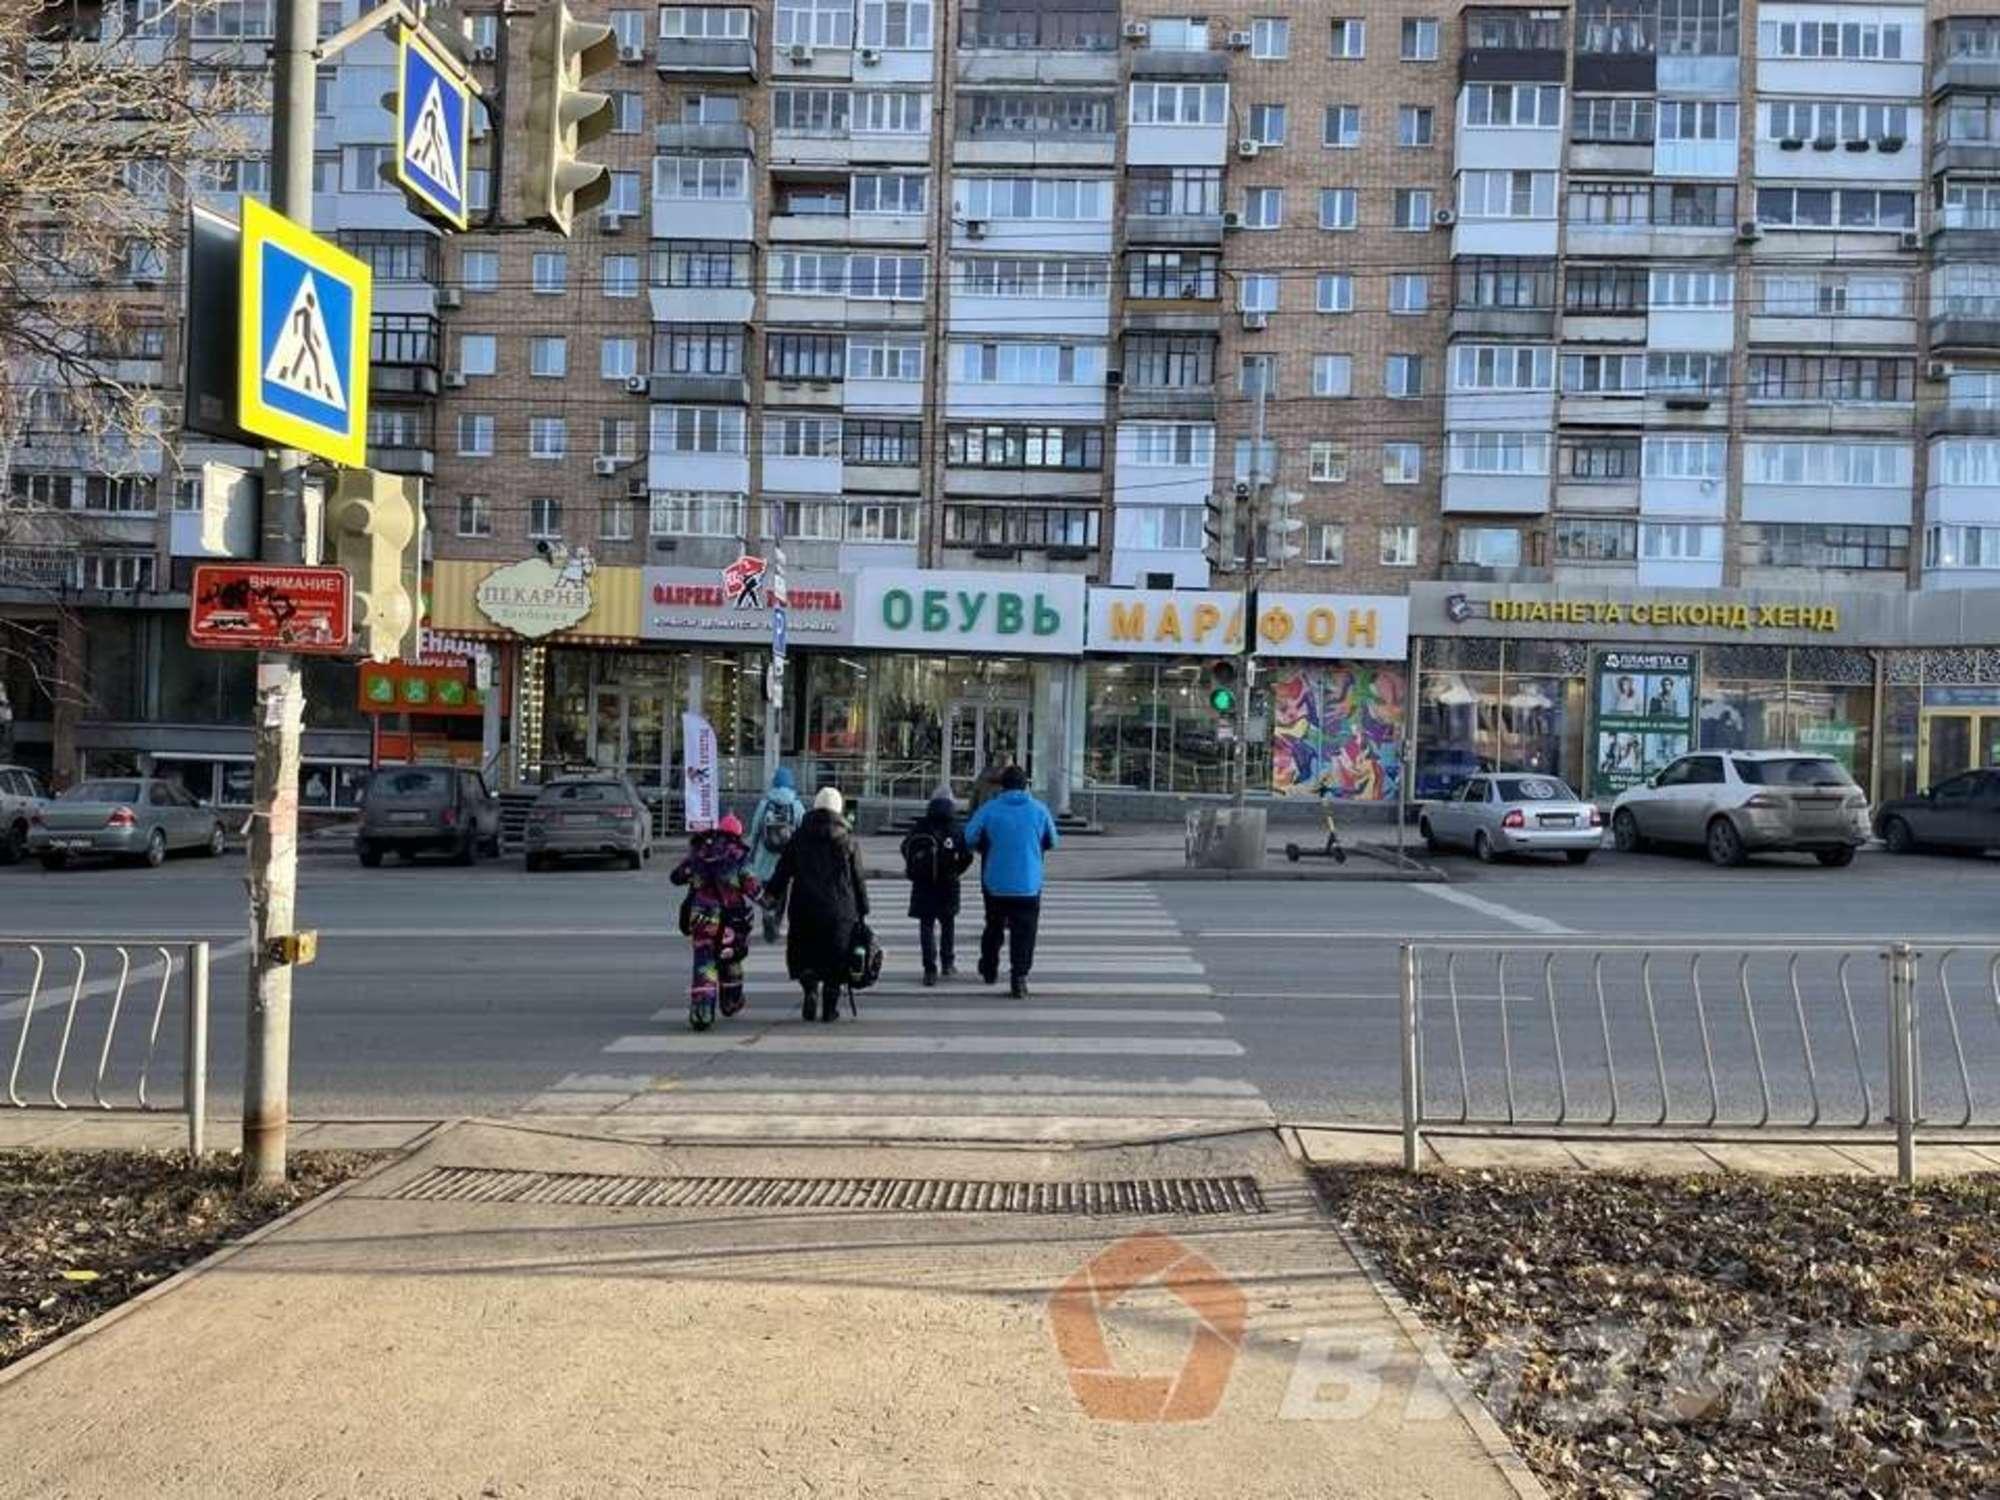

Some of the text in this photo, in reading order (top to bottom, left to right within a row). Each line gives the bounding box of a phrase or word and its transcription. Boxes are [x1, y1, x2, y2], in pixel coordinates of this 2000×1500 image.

[250, 574, 341, 592] ВНИМАНИЕ!
[882, 589, 1061, 636] ОБУВЬ
[1490, 600, 1840, 632] ПЛАНЕТА СЕКОНД ХЕНД
